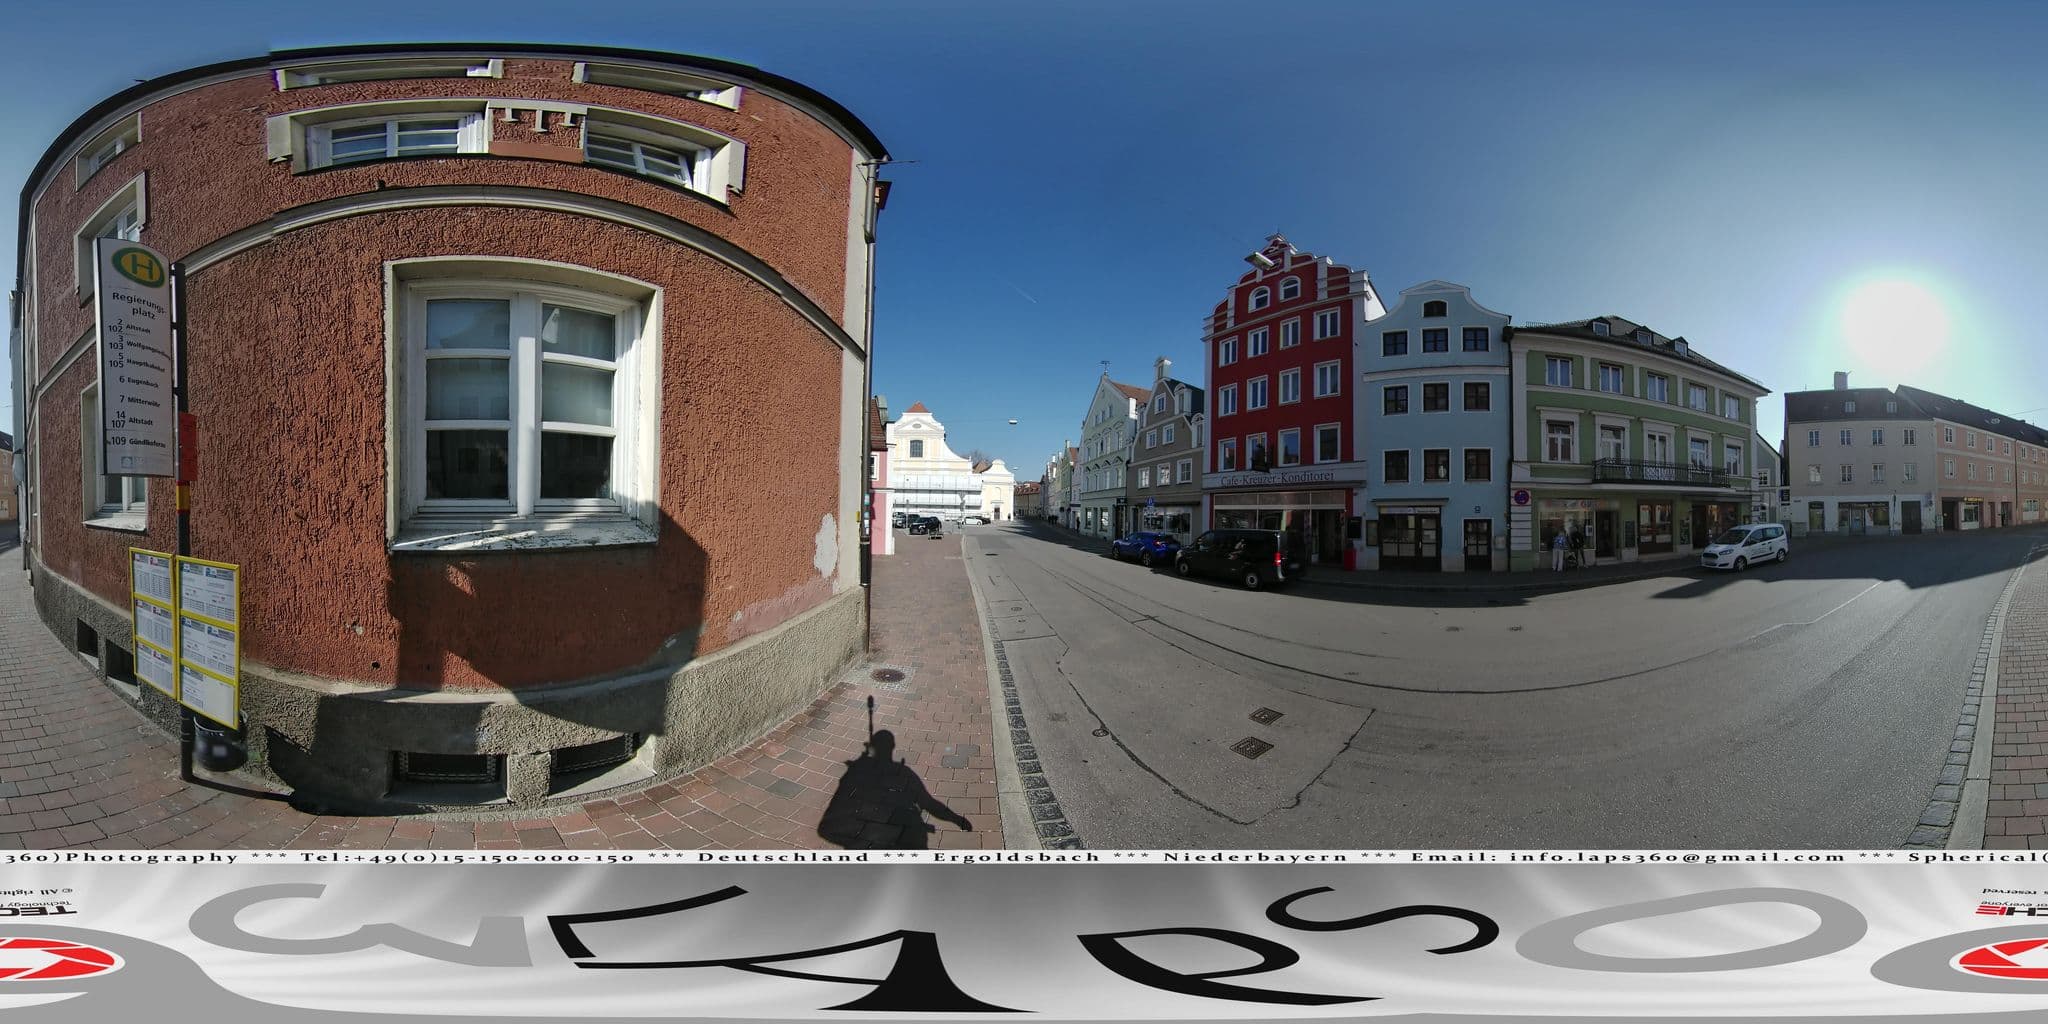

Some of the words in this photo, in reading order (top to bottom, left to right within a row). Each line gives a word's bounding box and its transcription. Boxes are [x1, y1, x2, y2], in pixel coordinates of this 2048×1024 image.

[132, 307, 156, 320] platz
[109, 325, 123, 333] 102
[126, 324, 151, 334] Altstadt
[109, 342, 124, 350] 103
[118, 352, 124, 360] 5
[109, 360, 124, 368] 105
[119, 395, 125, 403] 7
[116, 411, 126, 419] 14
[111, 420, 126, 428] 107
[128, 417, 153, 426] Altstadt
[111, 436, 127, 446] 109
